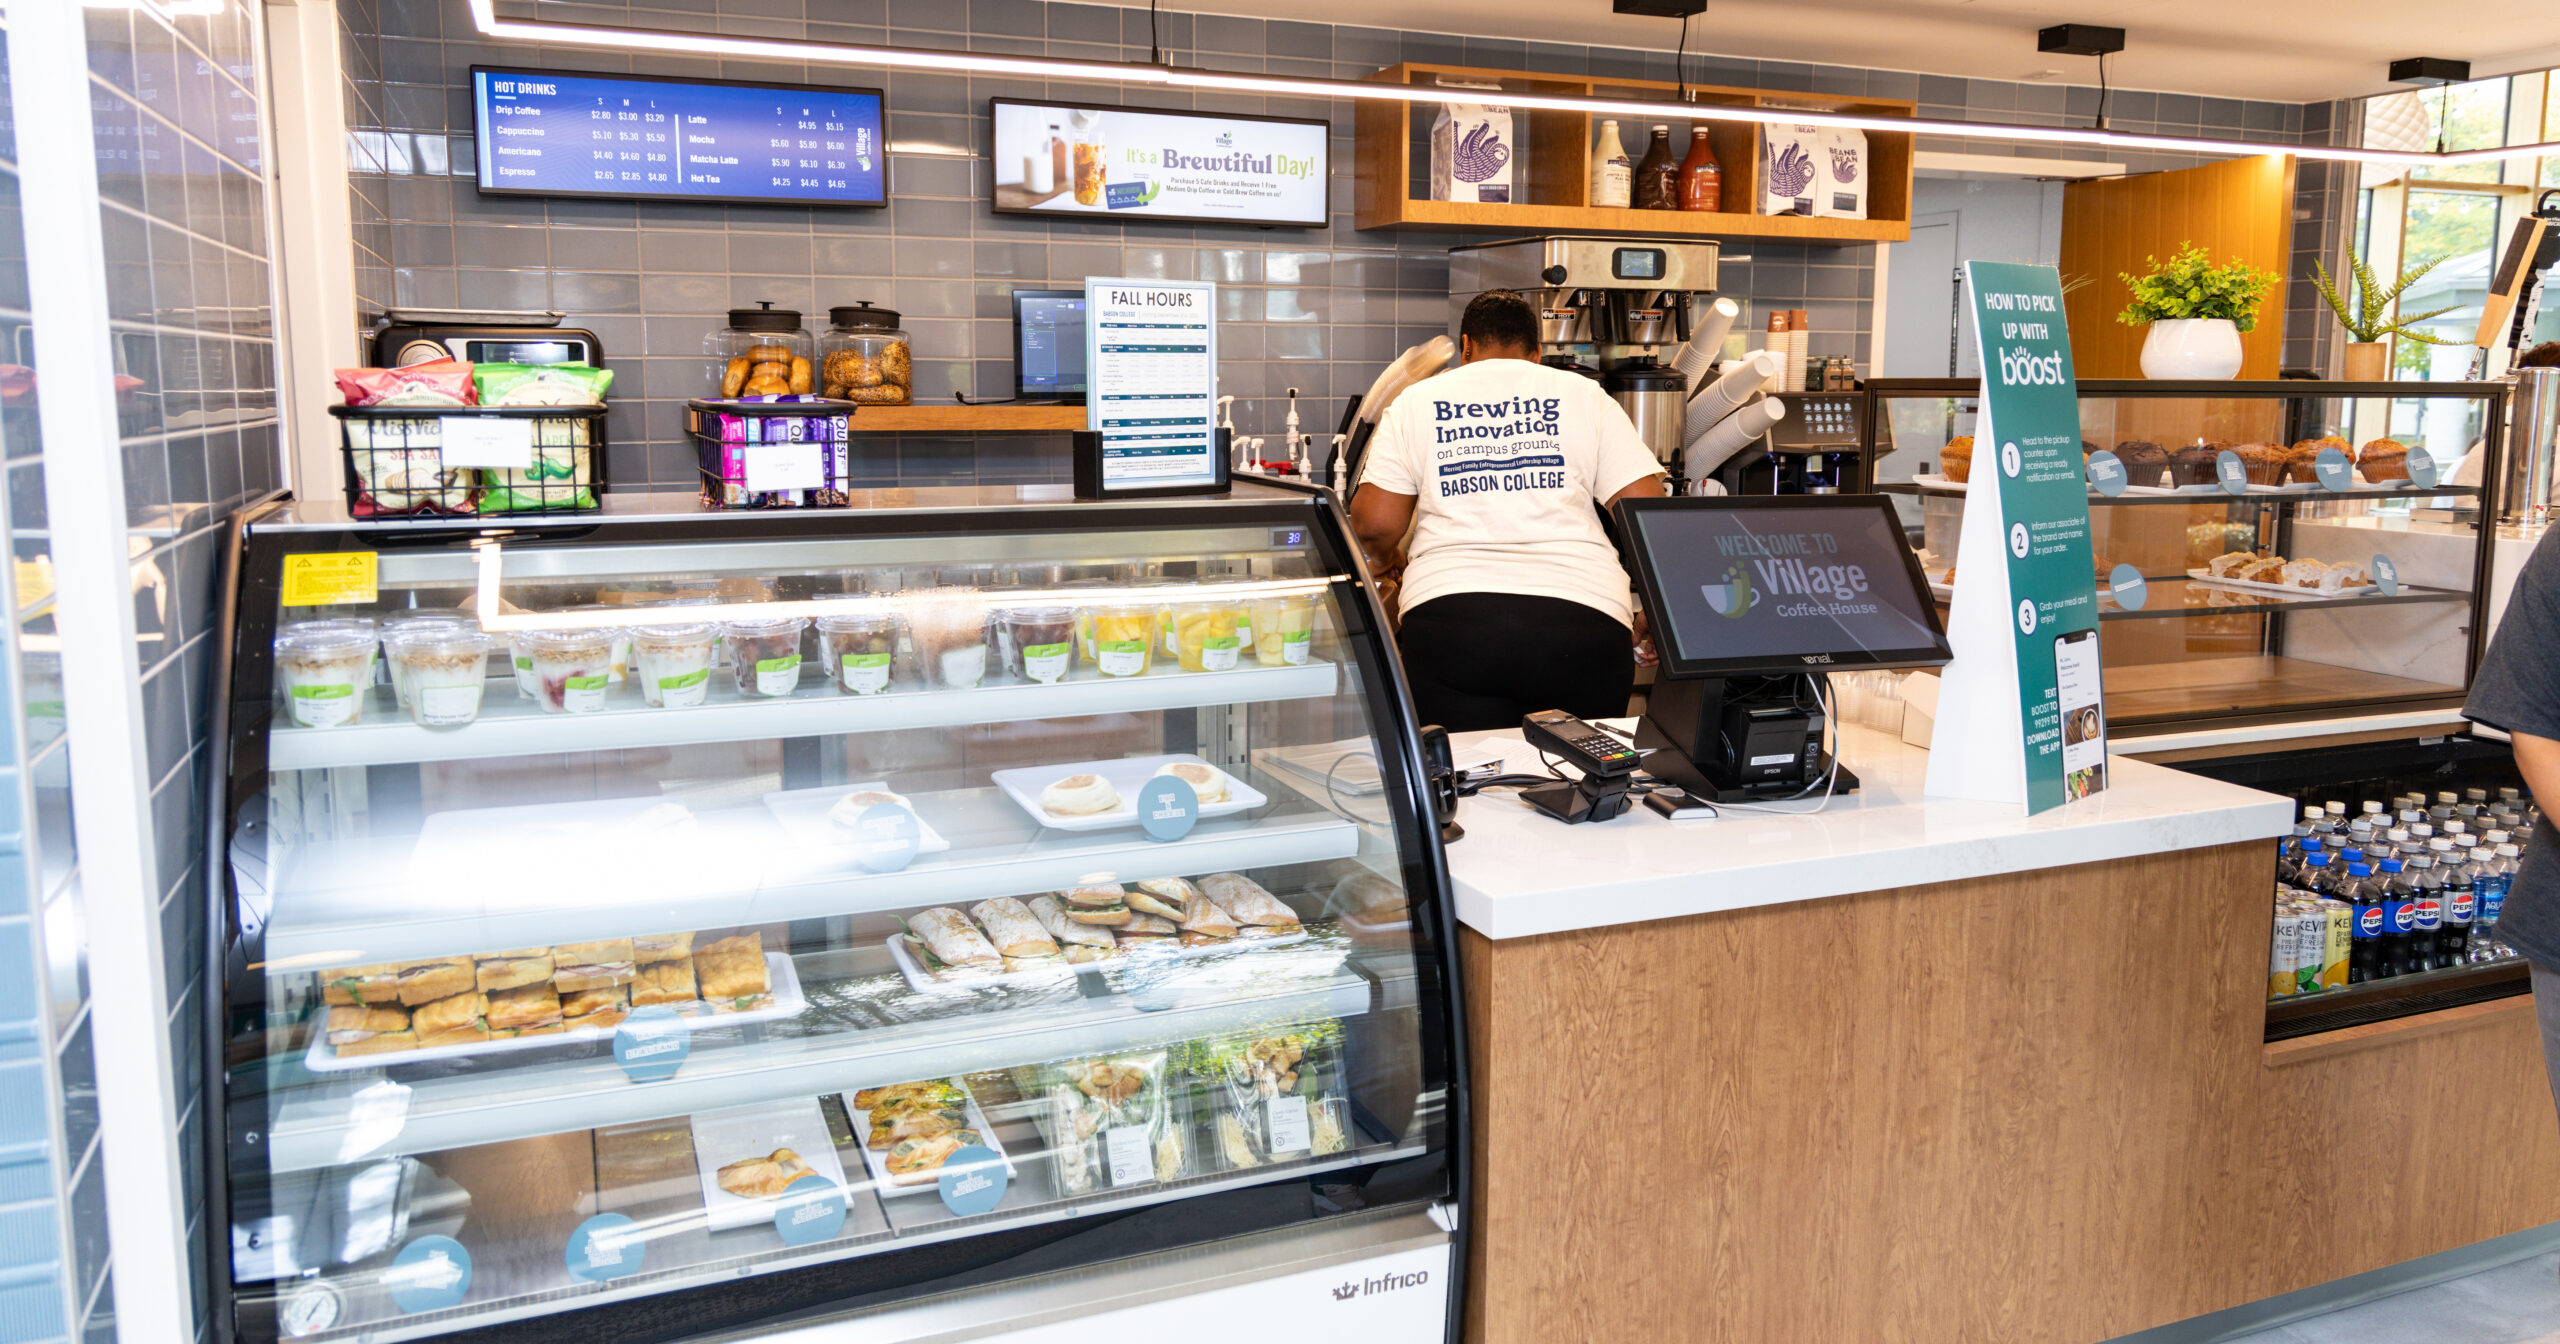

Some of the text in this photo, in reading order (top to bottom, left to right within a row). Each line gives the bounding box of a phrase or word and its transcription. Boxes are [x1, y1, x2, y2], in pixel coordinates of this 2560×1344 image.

[494, 81, 557, 96] HOT DRINKS
[623, 99, 630, 107] M
[496, 105, 541, 116] Drip Coffee
[618, 112, 638, 121] $3.00
[645, 113, 664, 122] $3.20
[688, 115, 707, 124] Latte
[798, 121, 844, 131] $4.95 $5.15
[497, 126, 545, 137] Cappuccino
[592, 130, 666, 142] $5.10 $5.30 $5.50
[689, 134, 715, 144] Mocha
[856, 127, 868, 156] Village
[1215, 136, 1233, 146] Village
[498, 146, 542, 157] Americano
[690, 154, 738, 165] Matcha Latte
[1127, 148, 1314, 180] It's a Brewtiful Day!
[499, 167, 536, 177] Espresso
[594, 170, 614, 180] $2.65
[691, 174, 720, 184] Hot Tea
[772, 177, 791, 187] $4.25
[801, 178, 819, 188] $4.45
[1111, 290, 1193, 307] FALL HOURS
[1984, 293, 2056, 312] HOW TO PICK
[2002, 322, 2049, 340] UP WITH
[1999, 346, 2066, 386] boost
[1433, 396, 1560, 421] Brewing
[1436, 417, 1559, 443] Innovation
[835, 418, 847, 460] QUEST
[2023, 437, 2037, 445] Head
[2044, 436, 2053, 444] the
[1437, 449, 1453, 460] on
[1456, 443, 1508, 457] campus
[2024, 449, 2058, 458] counter upon
[1462, 463, 1478, 472] Family
[1542, 457, 1560, 465] Village
[2008, 451, 2014, 470] 1
[2025, 461, 2049, 471] receiving
[2053, 460, 2068, 469] ready
[1440, 471, 1565, 497] BABSON COLLEGE
[2026, 472, 2054, 483] notification
[2031, 522, 2047, 531] Inform
[1288, 532, 1300, 544] 38
[2017, 532, 2023, 550] 2
[2033, 534, 2042, 543] the
[2042, 532, 2058, 542] brand
[2058, 532, 2068, 540] and
[1714, 533, 1838, 557] WELCOME TO
[2042, 546, 2053, 556] your
[1754, 558, 1869, 600] Village
[1776, 602, 1878, 617] Coffee House
[2039, 595, 2088, 612] Grab your meal and
[2025, 608, 2031, 626] 3
[2040, 613, 2056, 625] enjoy!
[2044, 687, 2057, 699] TEXT
[2031, 701, 2058, 717] BOOST TO
[2034, 715, 2058, 729] 99299 TO
[2027, 728, 2060, 746] DOWNLOAD
[2039, 741, 2061, 756] THE APP
[1364, 1270, 1428, 1296] Infrico
